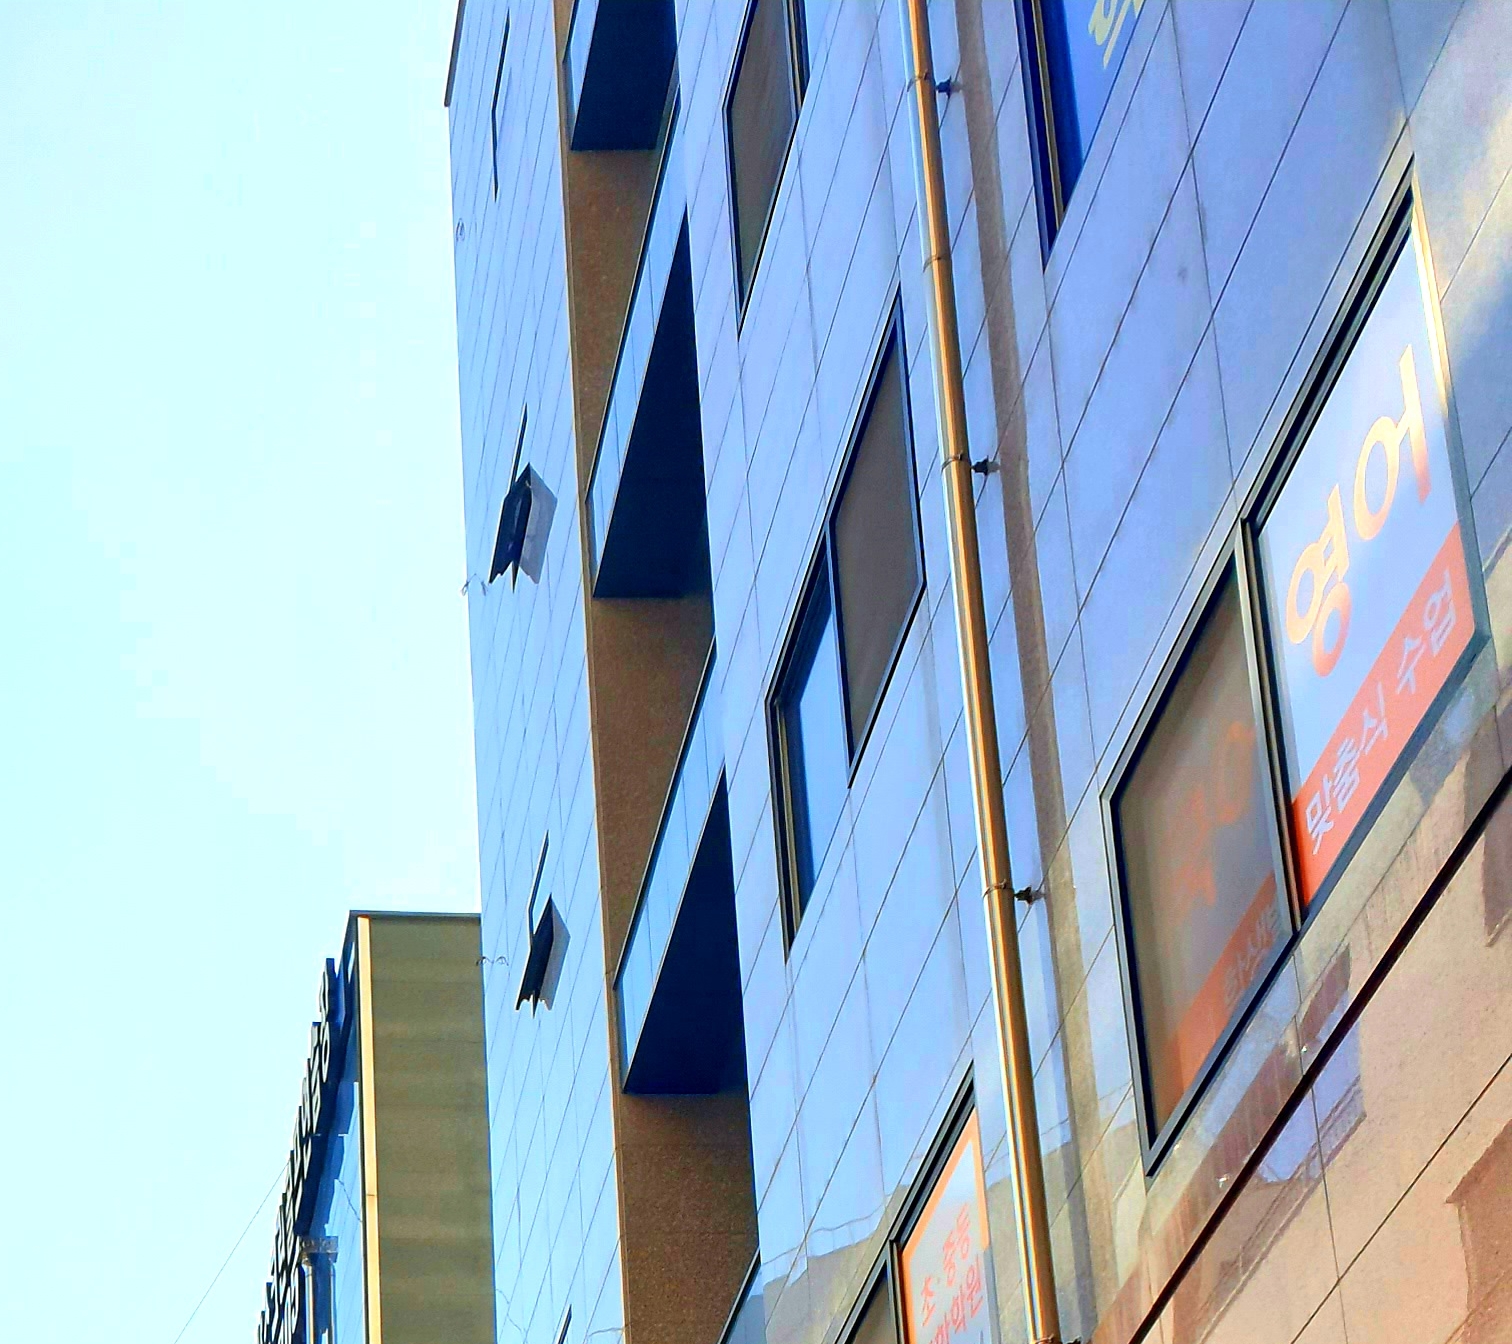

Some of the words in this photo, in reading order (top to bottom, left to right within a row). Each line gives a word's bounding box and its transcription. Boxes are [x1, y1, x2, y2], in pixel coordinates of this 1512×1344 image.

[1287, 344, 1431, 677] 영어
[1305, 692, 1389, 856] 맞춤식
[1396, 570, 1457, 695] 수업
